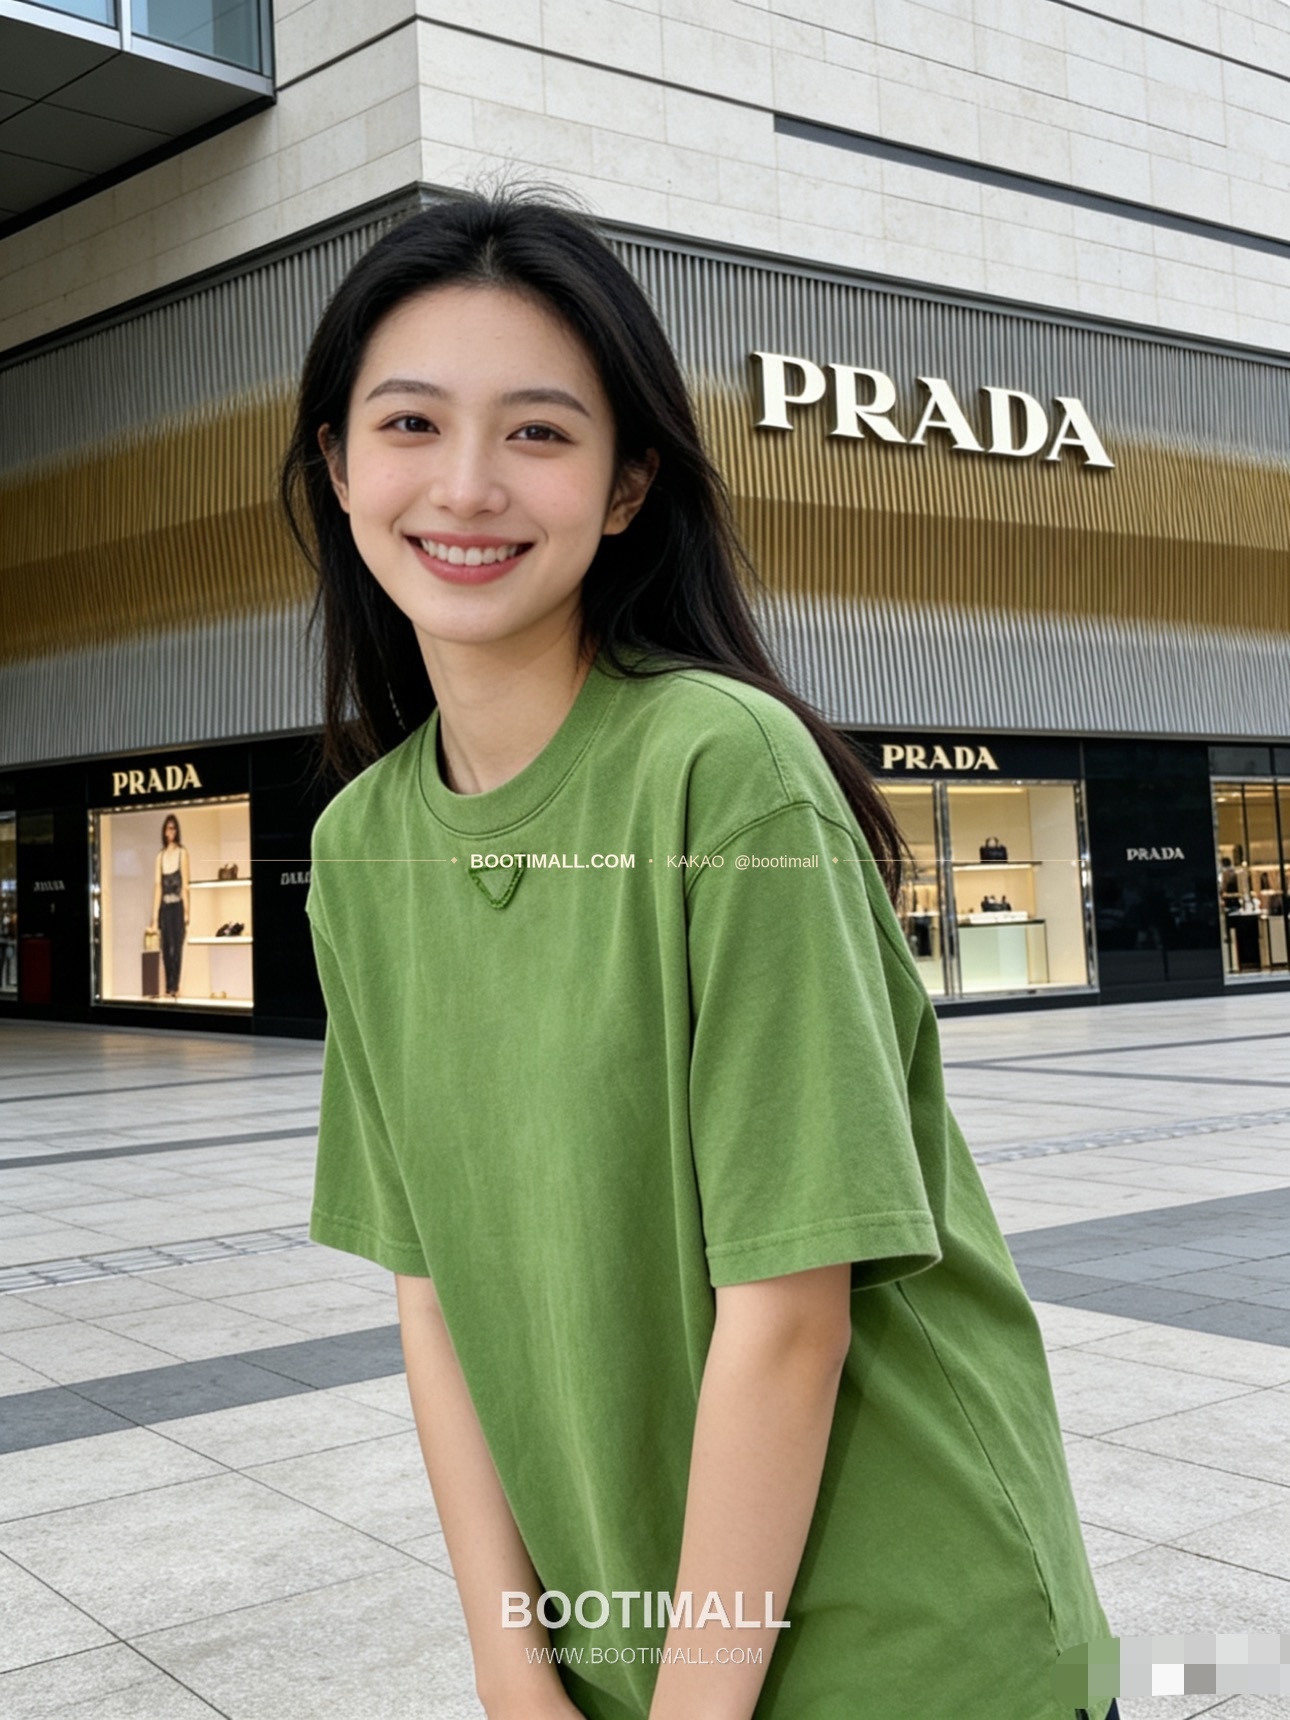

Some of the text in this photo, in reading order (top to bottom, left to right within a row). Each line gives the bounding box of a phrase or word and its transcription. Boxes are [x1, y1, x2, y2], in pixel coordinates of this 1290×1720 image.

[750, 351, 1115, 468] PRADA
[882, 744, 999, 771] PRADA
[112, 764, 202, 796] PRADA
[1126, 847, 1185, 860] PRADA
